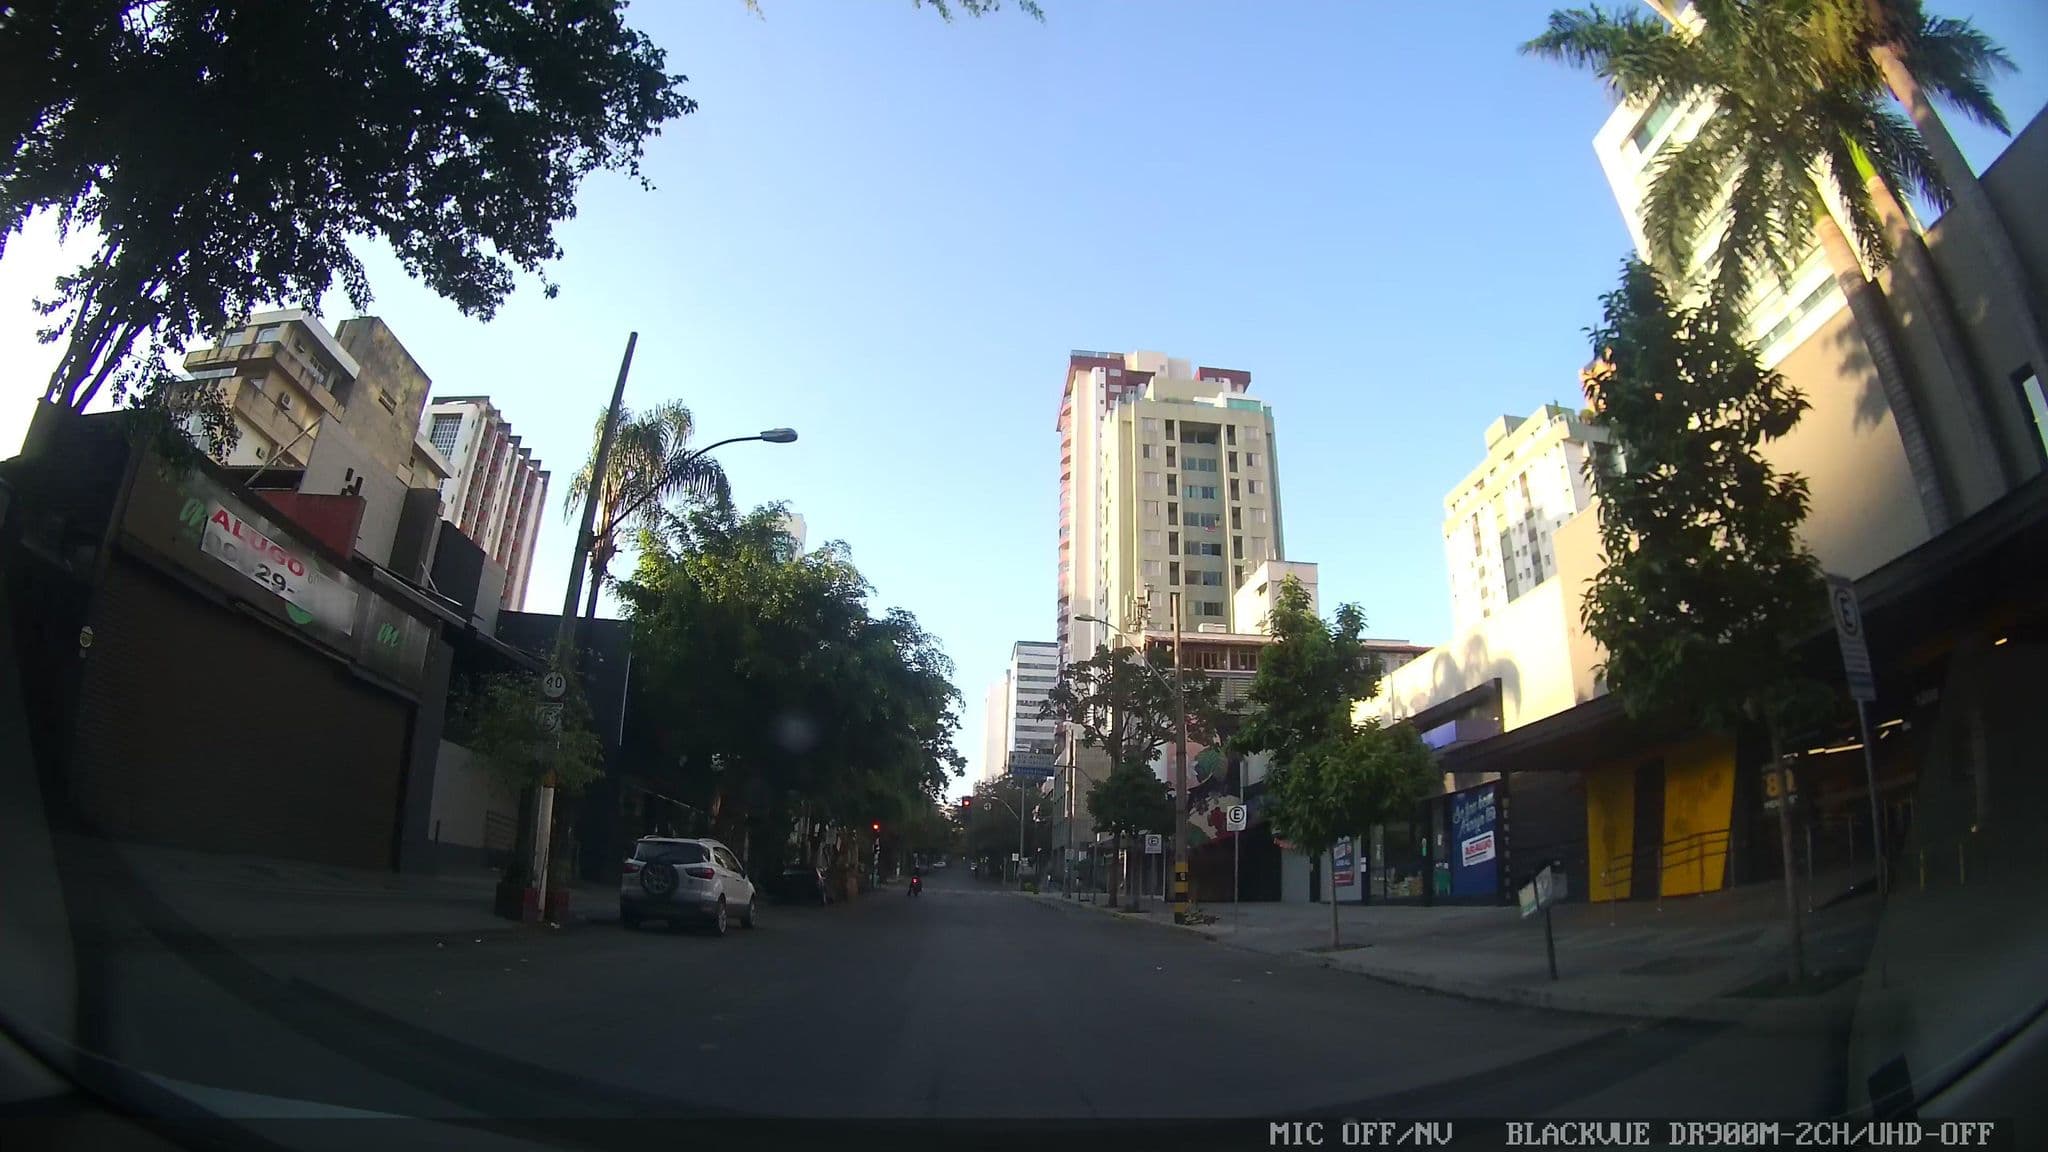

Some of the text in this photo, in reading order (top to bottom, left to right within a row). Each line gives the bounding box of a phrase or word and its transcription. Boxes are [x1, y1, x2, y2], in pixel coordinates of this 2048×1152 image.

[212, 508, 305, 577] ALUGO
[546, 677, 562, 688] 40
[1233, 809, 1241, 819] E
